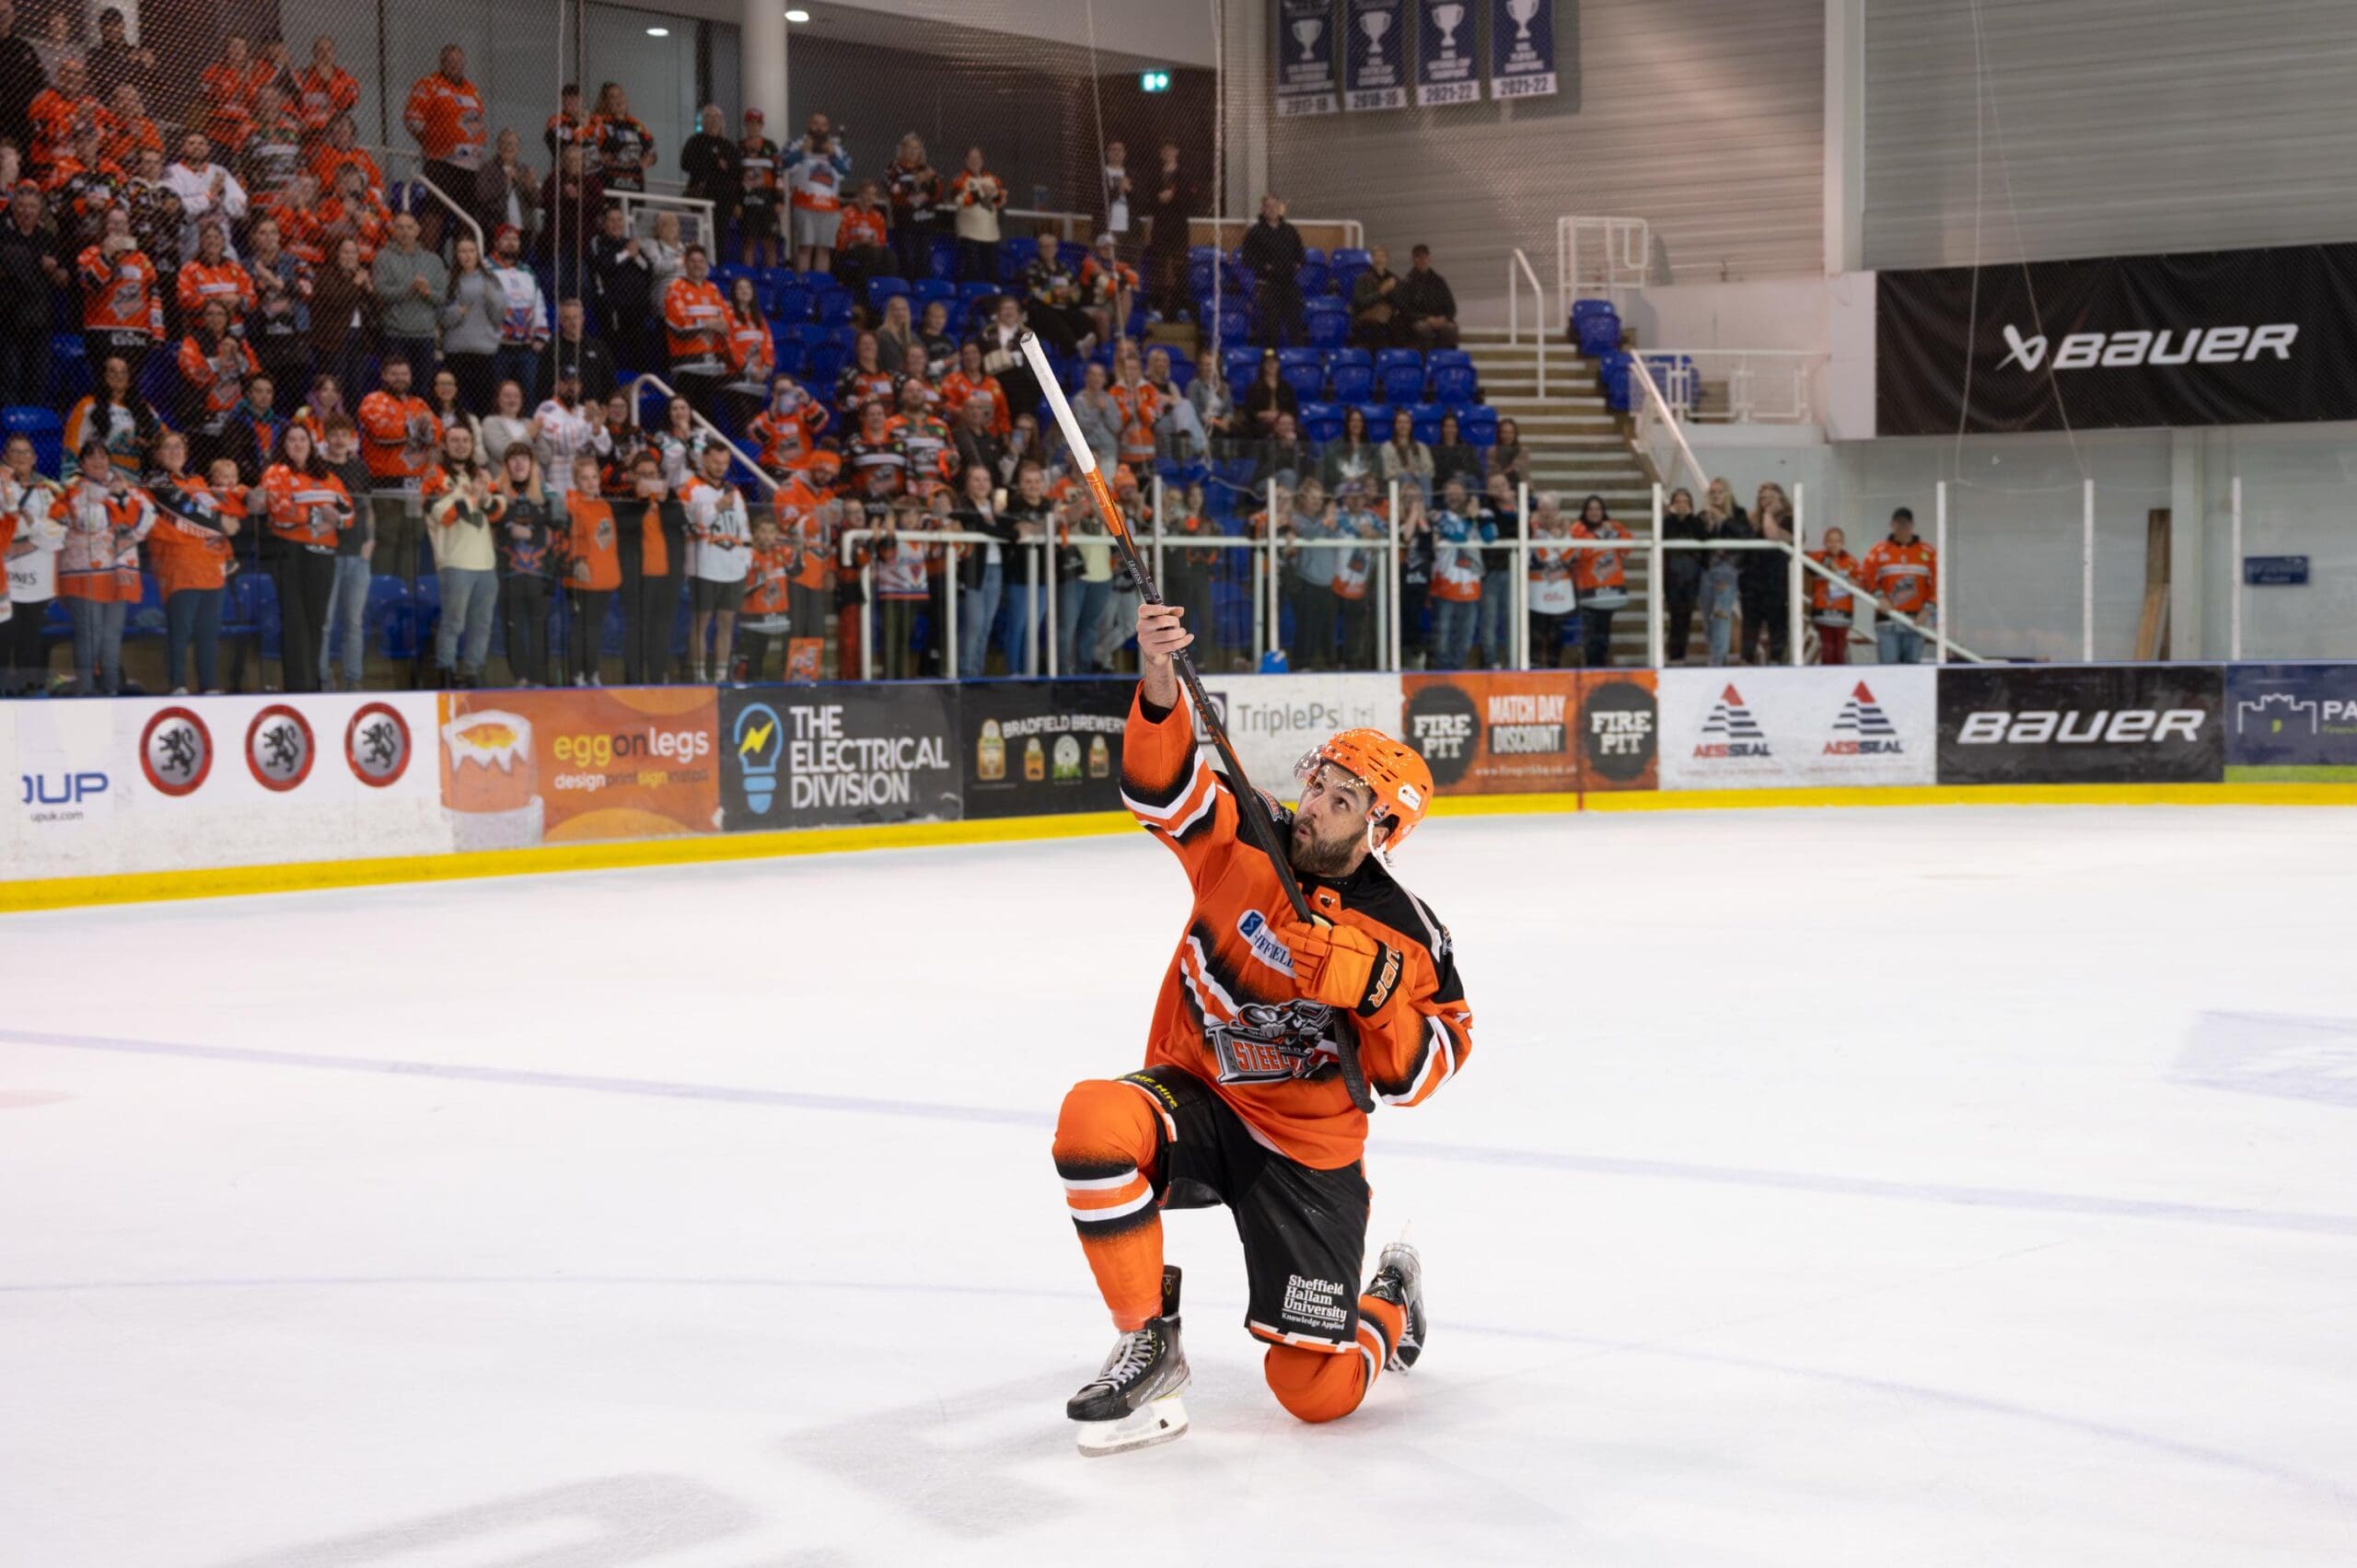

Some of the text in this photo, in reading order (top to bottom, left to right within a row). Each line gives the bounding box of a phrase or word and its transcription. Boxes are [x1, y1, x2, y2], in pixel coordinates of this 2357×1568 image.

[2052, 324, 2299, 368] BAUER
[789, 705, 843, 739] THE
[1237, 703, 1340, 737] TriplePs
[1488, 695, 1567, 724] MATCH DAY
[1002, 714, 1070, 739] BRADFIELD
[1413, 714, 1472, 738] FIRE
[1591, 711, 1653, 734] FIRE
[1956, 710, 2207, 744] BAUER
[1422, 738, 1465, 759] PIT
[1492, 724, 1562, 753] DISCOUNT
[1600, 734, 1644, 755] PIT
[1692, 743, 1771, 758] AESSEAL
[1822, 740, 1903, 755] AESSEAL
[790, 737, 950, 774] ELECTRICAL
[791, 772, 910, 809] DIVISION
[1285, 1285, 1333, 1306] Hallam
[1288, 1273, 1344, 1295] Sheffield
[1281, 1311, 1345, 1331] Knowledge Applied
[1283, 1296, 1348, 1322] University
